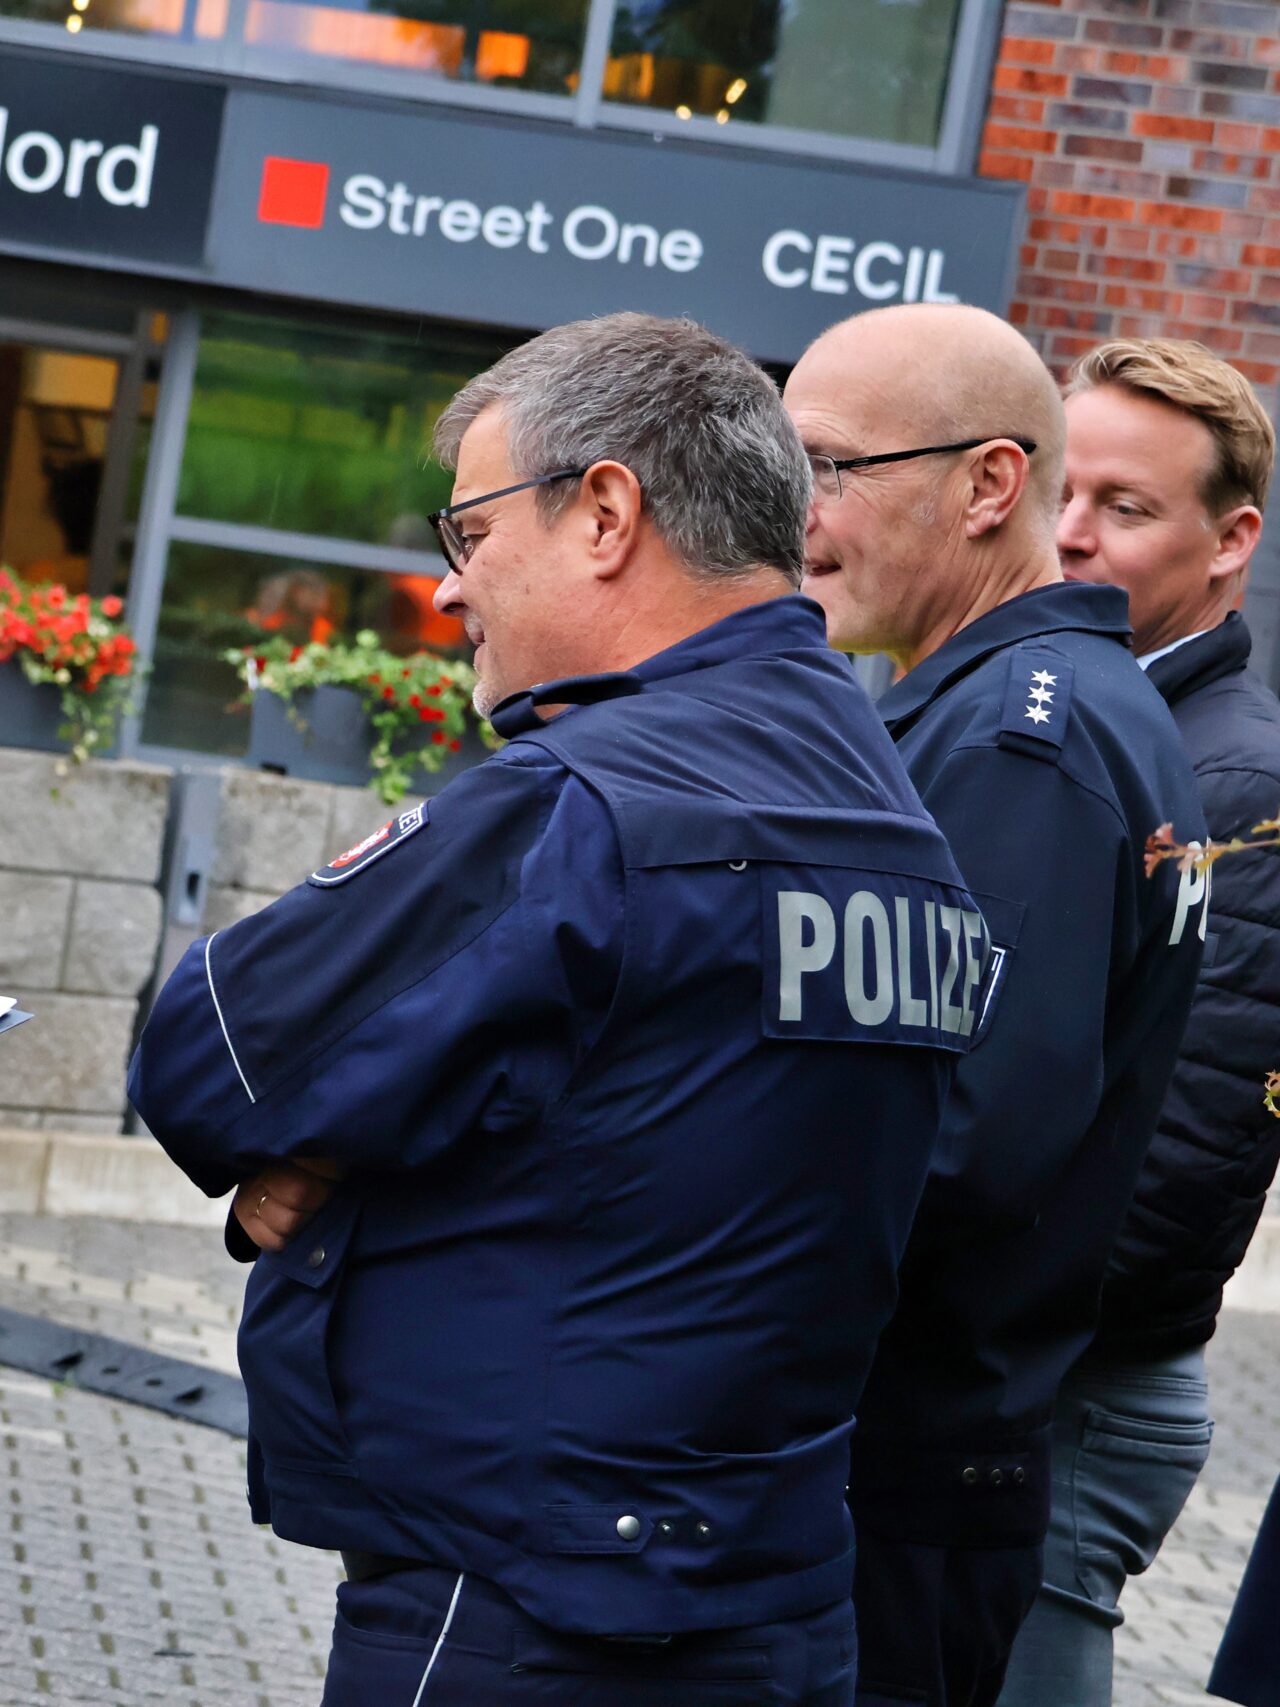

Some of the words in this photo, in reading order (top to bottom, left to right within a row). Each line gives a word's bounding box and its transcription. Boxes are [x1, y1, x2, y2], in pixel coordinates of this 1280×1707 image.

[339, 174, 554, 254] Street
[562, 205, 704, 273] One
[761, 229, 962, 304] CECIL
[776, 889, 983, 1037] POLIZE
